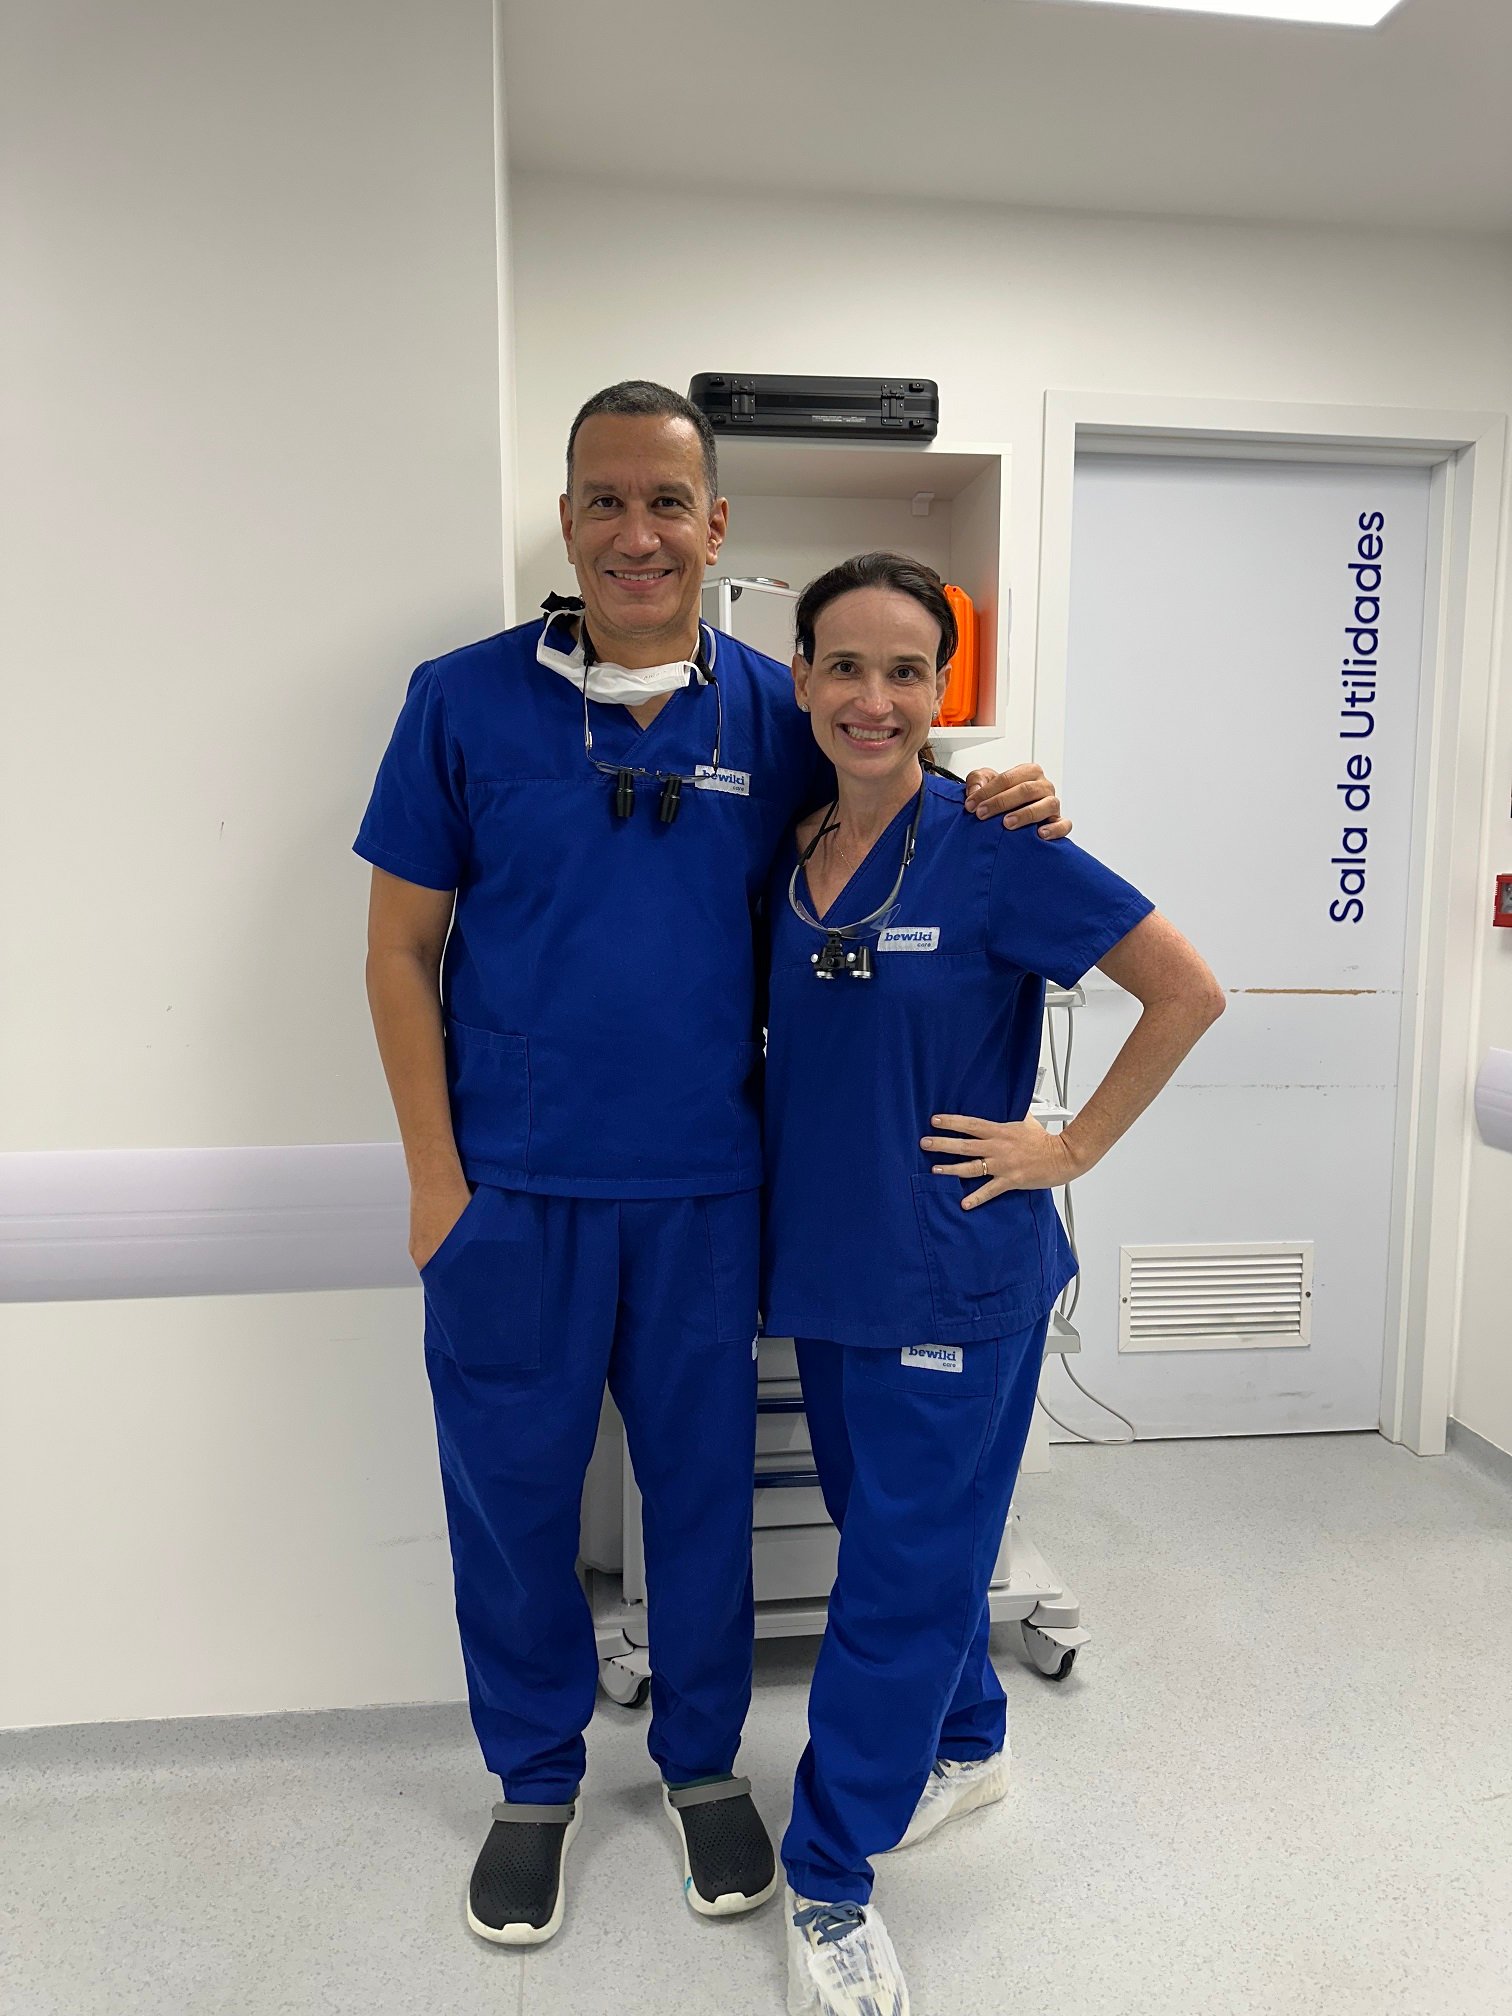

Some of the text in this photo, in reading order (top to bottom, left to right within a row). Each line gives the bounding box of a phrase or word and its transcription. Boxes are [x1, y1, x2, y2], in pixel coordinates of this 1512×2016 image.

[1329, 511, 1385, 924] Sala de Utilidades
[884, 931, 933, 942] bewiki
[908, 1345, 957, 1362] bewiki
